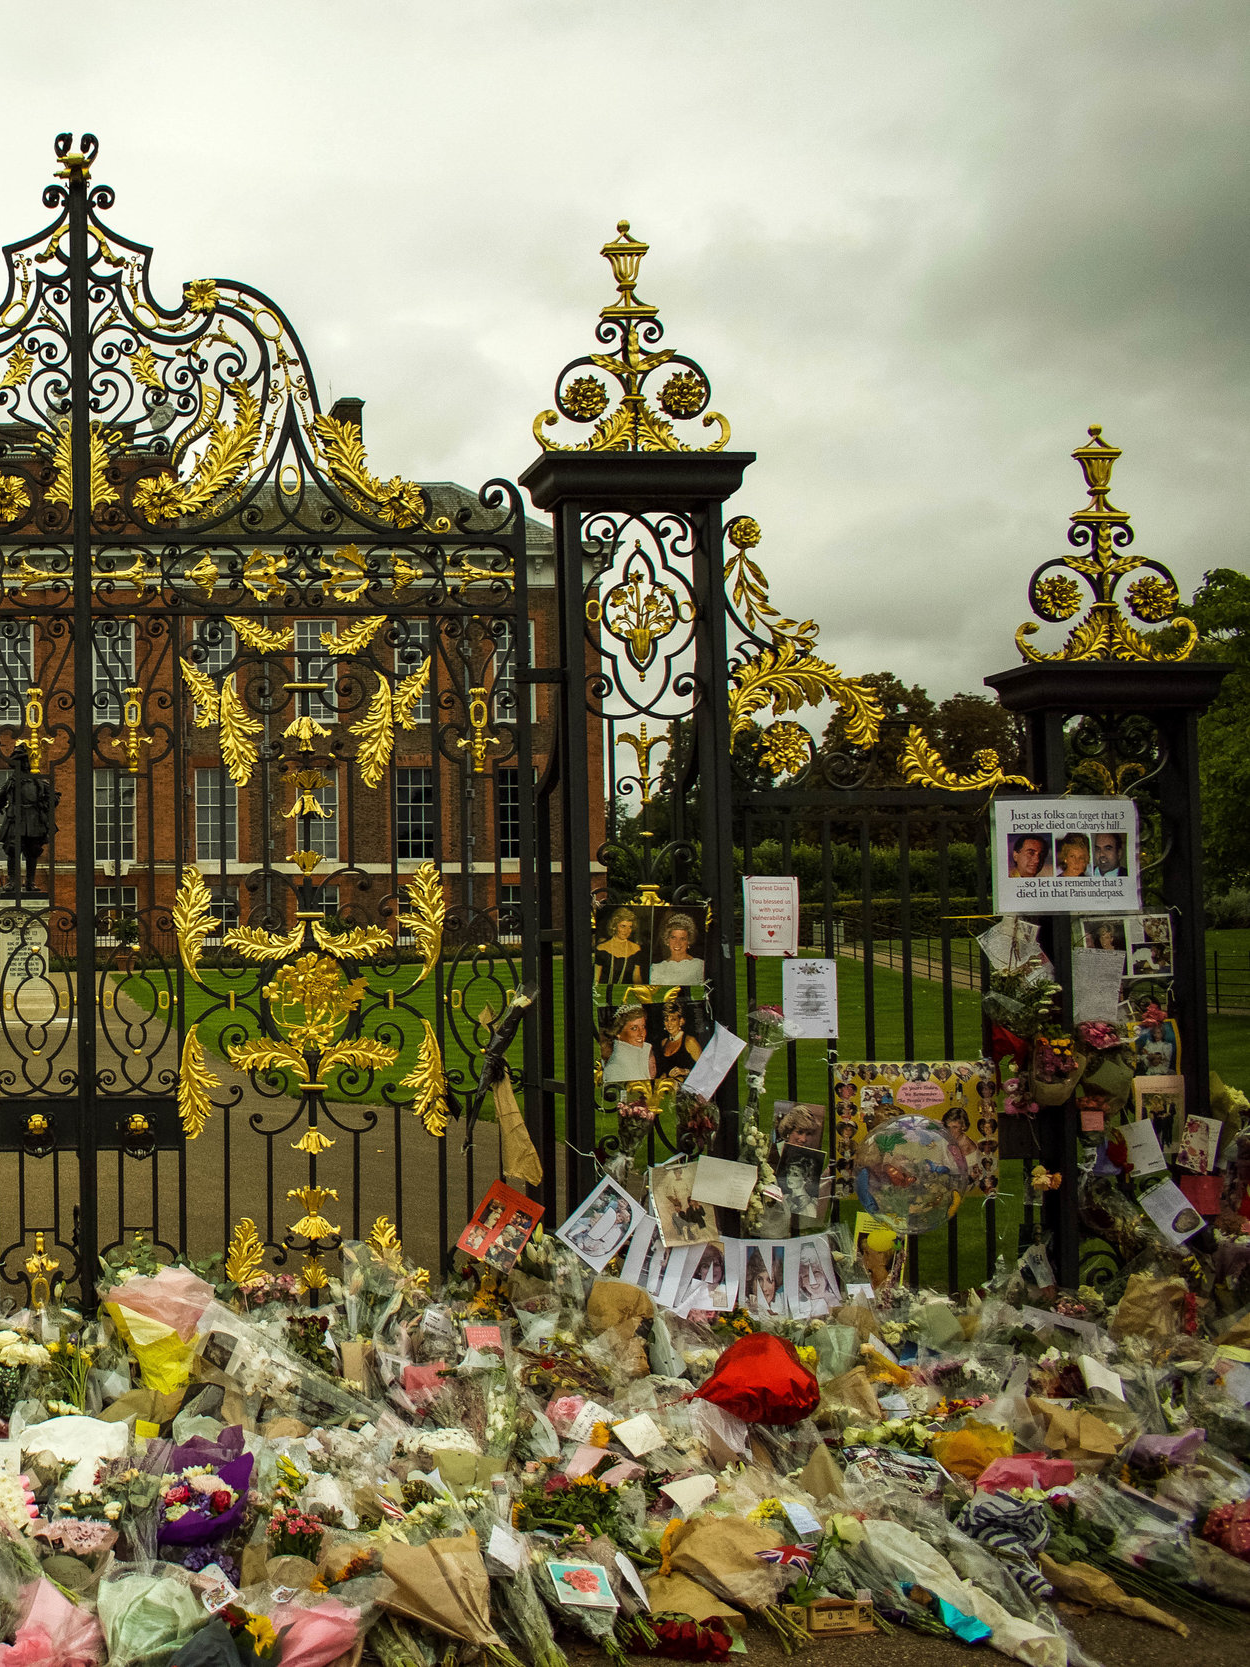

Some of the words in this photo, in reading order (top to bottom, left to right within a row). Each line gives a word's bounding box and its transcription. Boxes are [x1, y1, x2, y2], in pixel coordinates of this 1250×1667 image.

[1011, 809, 1029, 821] Just
[1044, 810, 1065, 819] folks
[1078, 810, 1099, 822] forget
[1101, 811, 1118, 819] that
[1119, 811, 1125, 820] 3
[1013, 821, 1044, 832] people
[1046, 821, 1065, 830] died
[1076, 821, 1105, 832] Calvary's
[1038, 878, 1051, 888] let
[1064, 878, 1101, 887] remember
[1102, 878, 1117, 887] that
[1118, 878, 1123, 887] 3
[1016, 889, 1037, 898] died
[1039, 889, 1049, 898] in
[1051, 888, 1068, 898] that
[1070, 888, 1086, 898] Paris
[1087, 888, 1124, 899] underpass.
